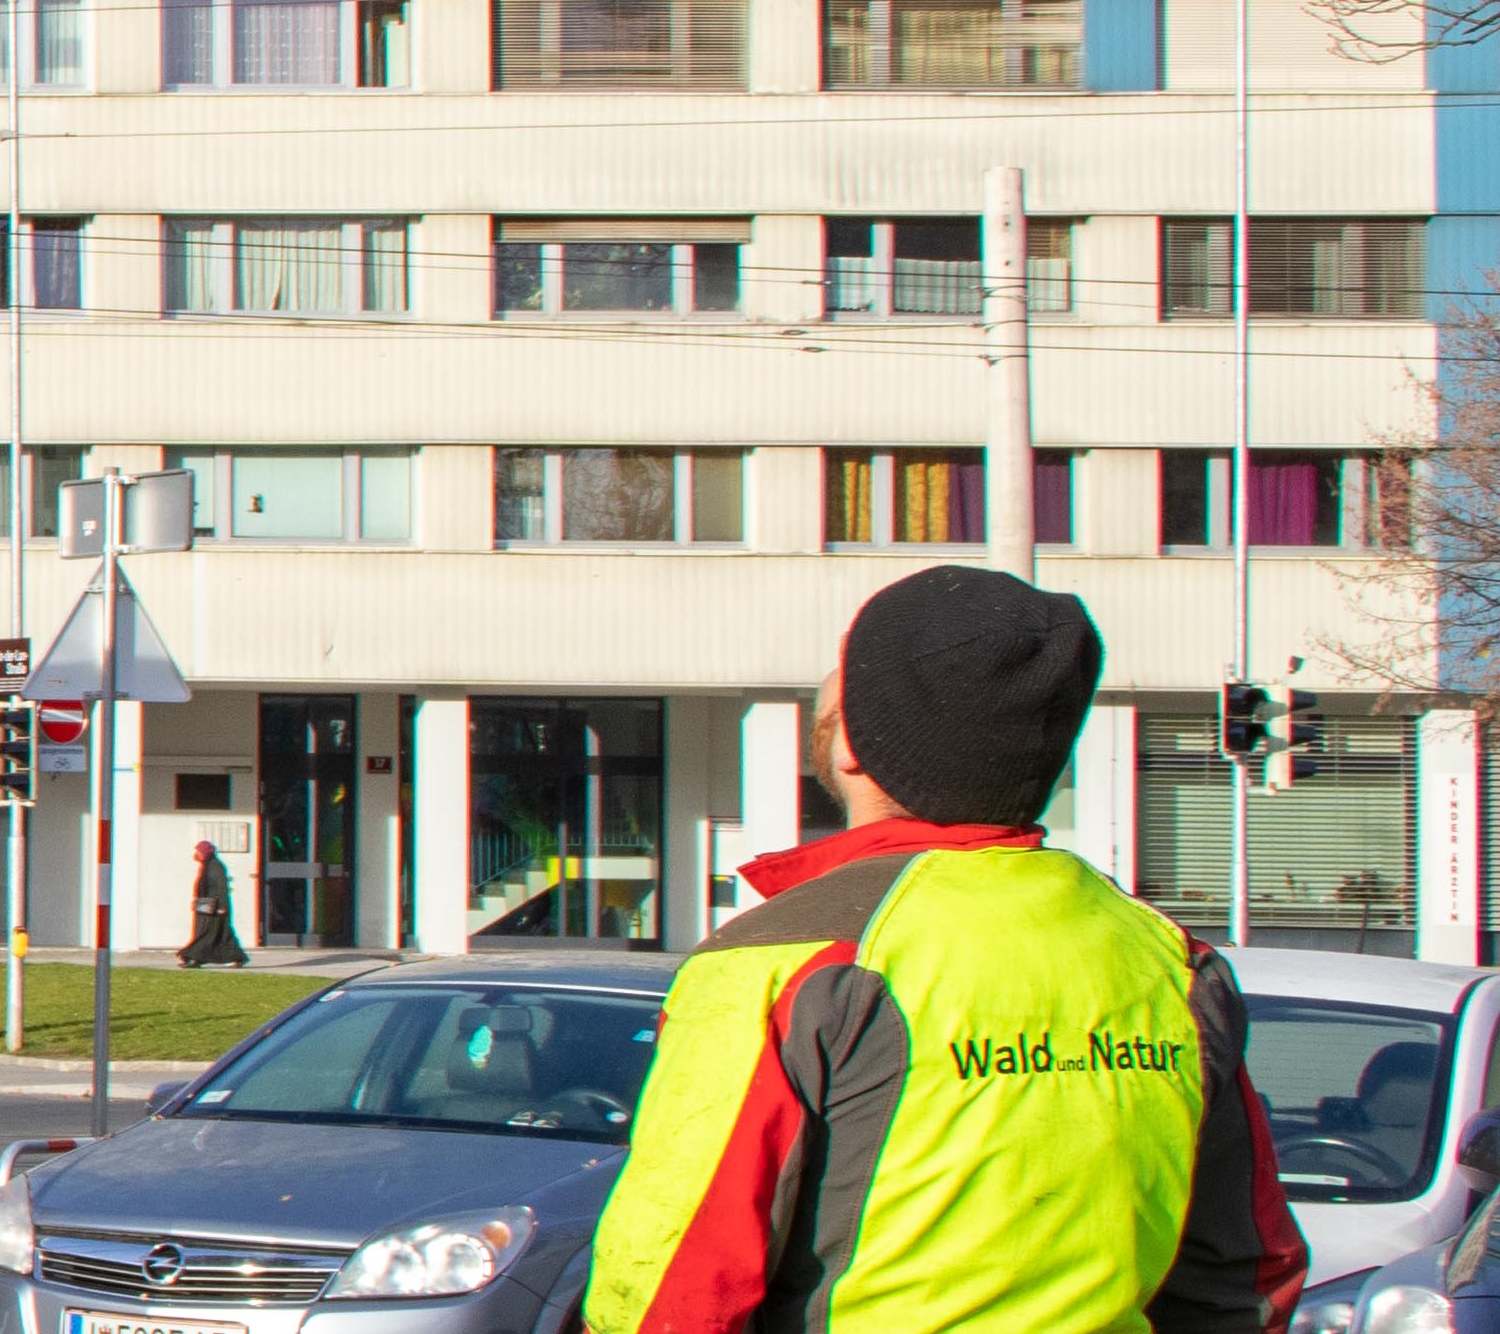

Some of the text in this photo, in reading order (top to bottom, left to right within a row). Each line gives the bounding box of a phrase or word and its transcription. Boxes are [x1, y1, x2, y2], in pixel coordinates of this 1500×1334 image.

[949, 1030, 1185, 1081] Wald und Natur
